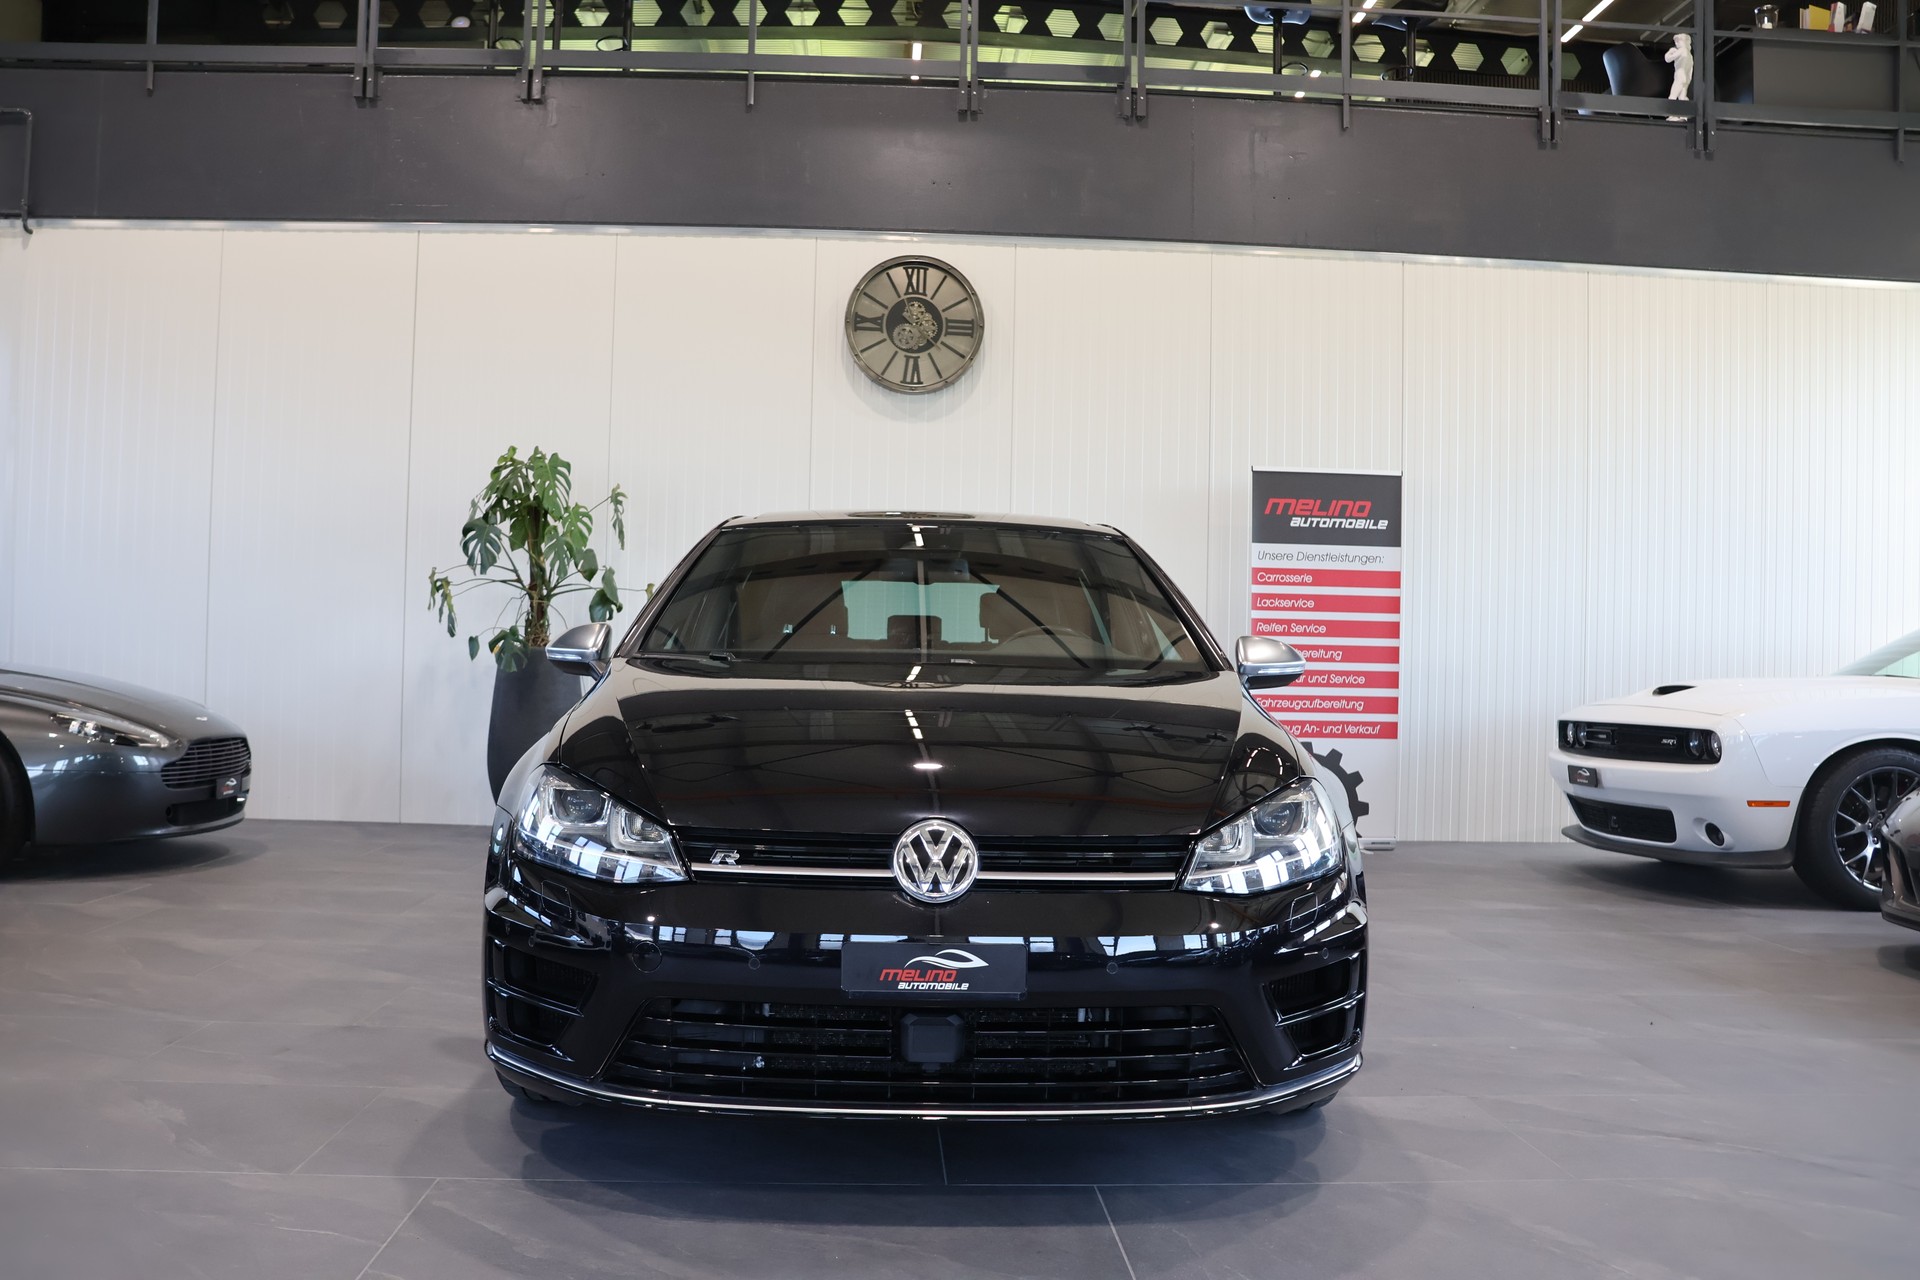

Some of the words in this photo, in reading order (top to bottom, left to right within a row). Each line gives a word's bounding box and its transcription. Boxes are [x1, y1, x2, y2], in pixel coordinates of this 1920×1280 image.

[903, 266, 929, 296] XII
[944, 317, 974, 338] III
[1257, 550, 1294, 562] Unsere
[1296, 551, 1385, 565] Dienstleistungen:
[1257, 572, 1313, 584] Carrosserie
[1257, 597, 1315, 608] Lackservice
[1256, 622, 1288, 633] Reifen
[1290, 623, 1327, 634] Service
[1308, 674, 1328, 684] und
[1330, 674, 1366, 685] Service
[1303, 724, 1320, 734] An-
[1323, 724, 1343, 734] und
[1344, 724, 1381, 735] Verkauf
